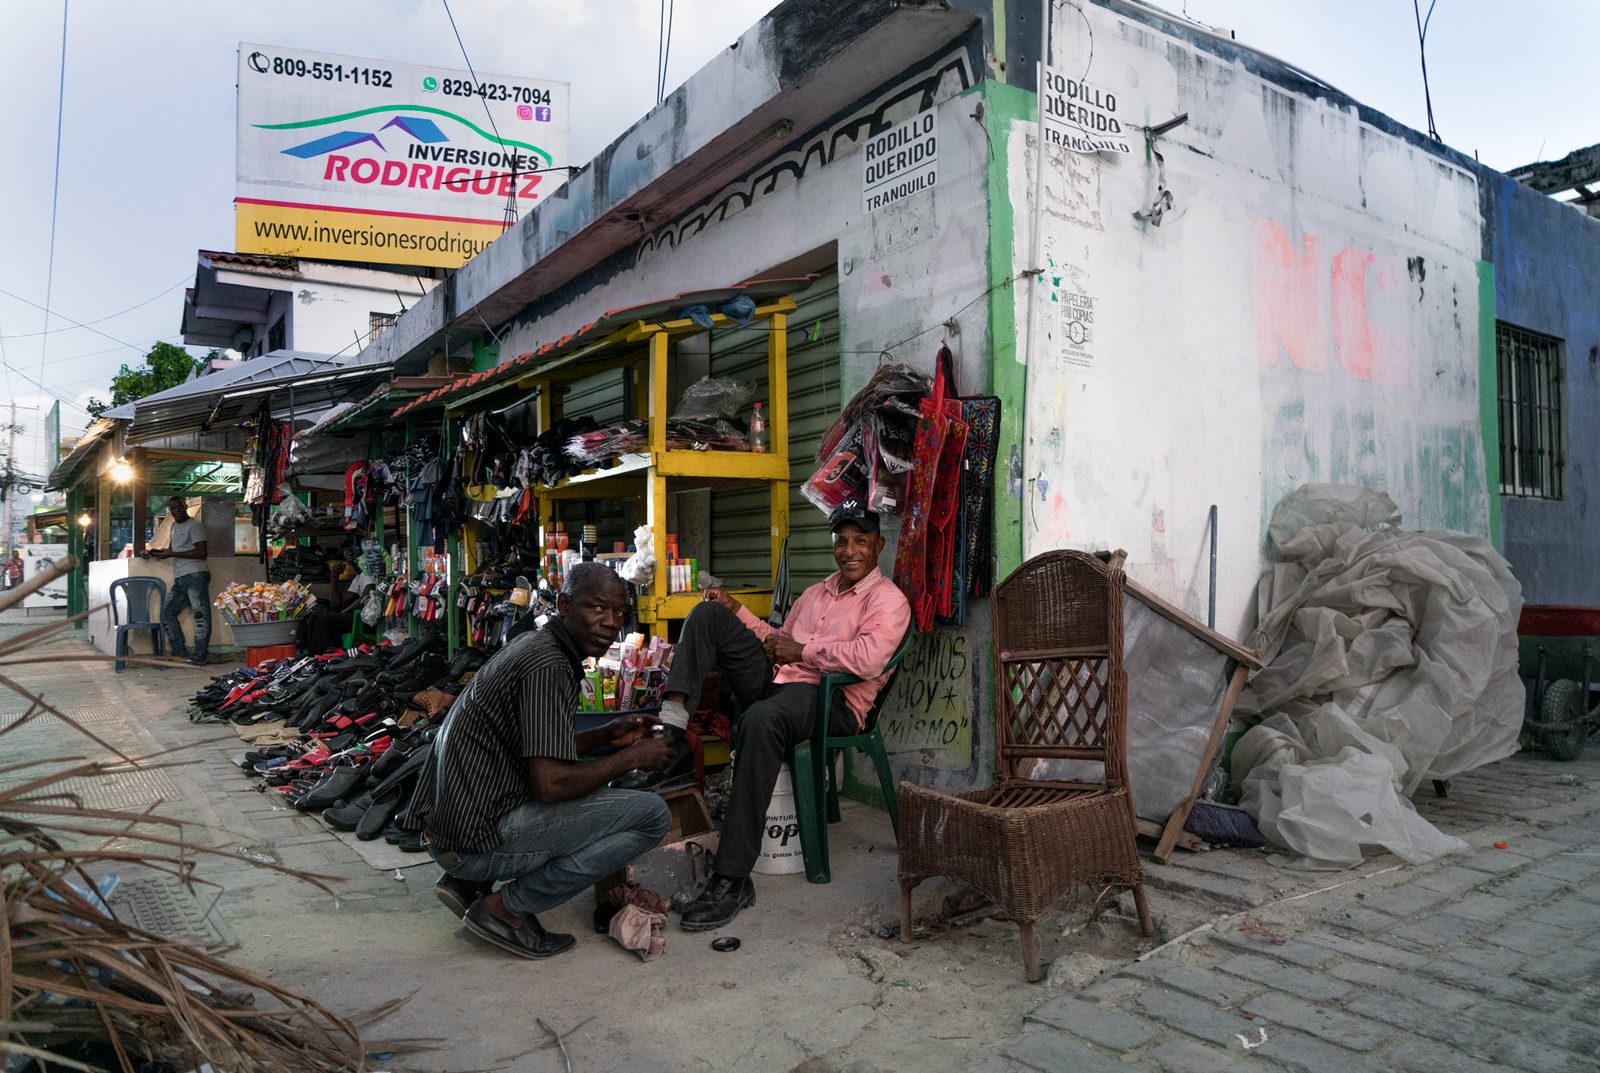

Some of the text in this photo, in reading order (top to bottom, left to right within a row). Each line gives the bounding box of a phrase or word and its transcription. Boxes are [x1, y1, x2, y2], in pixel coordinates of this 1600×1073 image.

[273, 57, 393, 88] 809-551-1152
[442, 79, 551, 106] 829-423-7094
[1045, 70, 1116, 113] RODILLO
[1045, 94, 1122, 134] QUERIDO
[866, 113, 934, 162] RODILLO
[1044, 127, 1130, 154] TRANQUILO
[408, 143, 539, 170] INVERSIONES
[866, 137, 937, 184] QUERIDO
[323, 154, 543, 199] RODRIGUEZ
[866, 171, 936, 212] TRANQUILO
[1061, 291, 1093, 309] PAPELERIA
[1073, 308, 1093, 323] COPIAS
